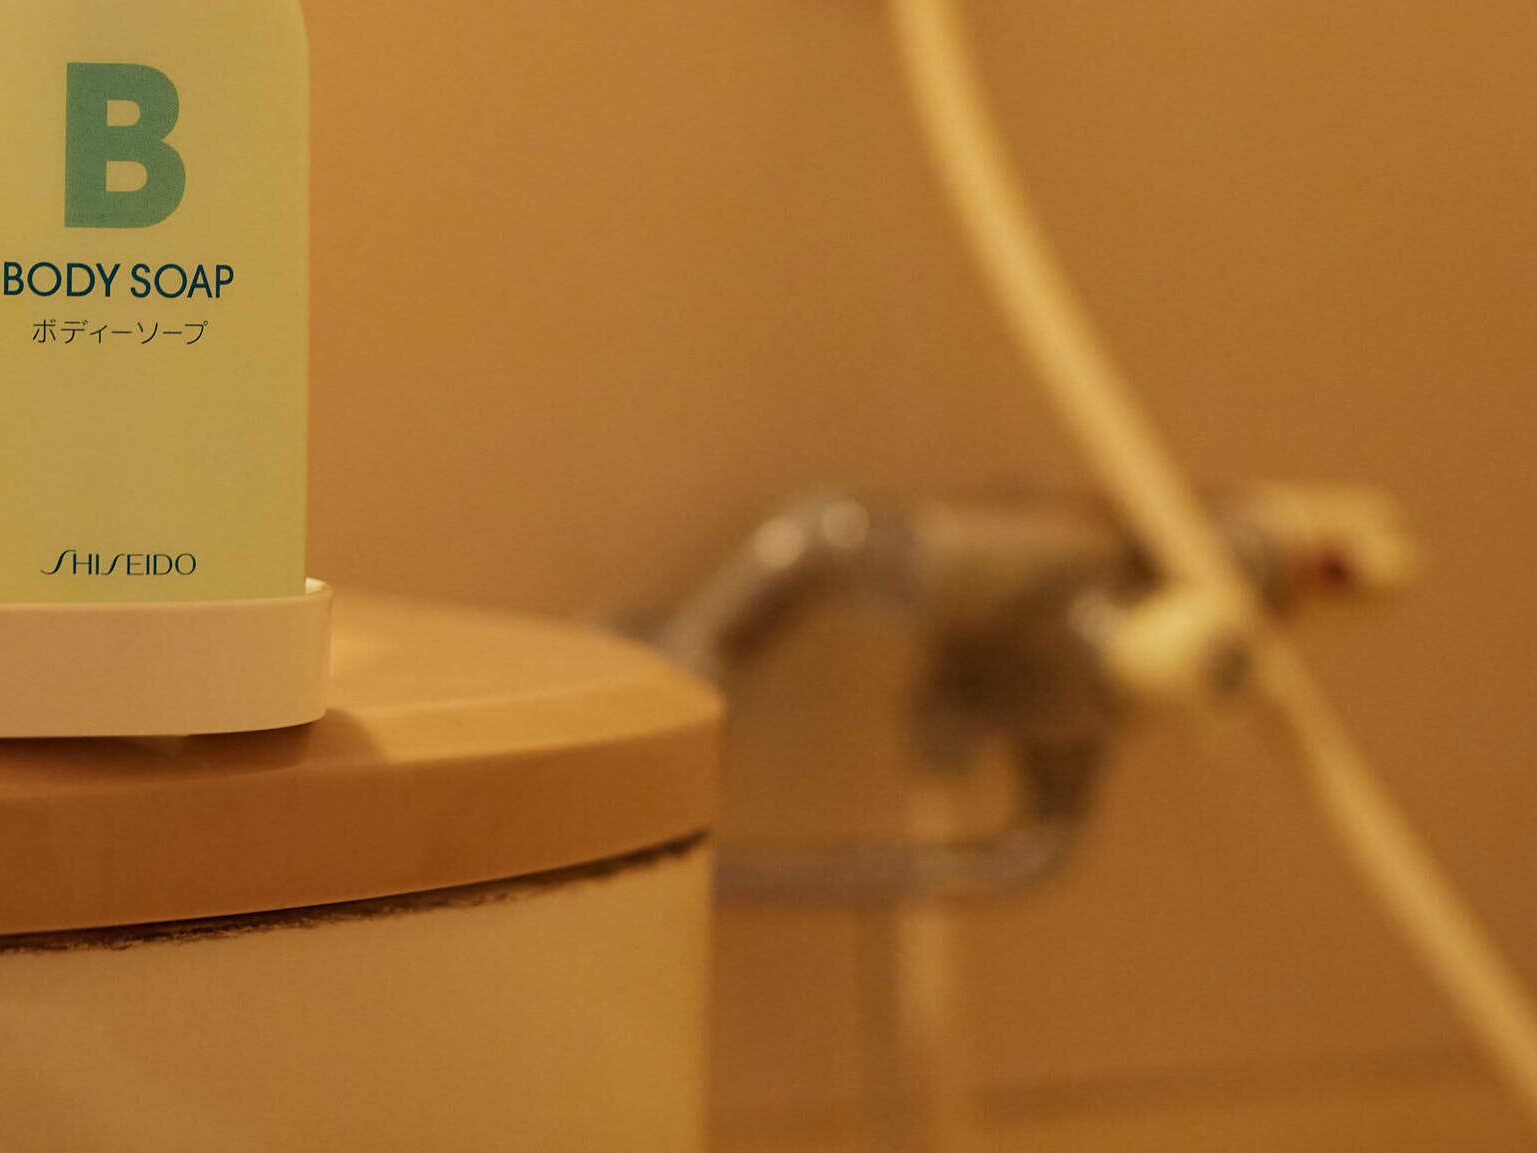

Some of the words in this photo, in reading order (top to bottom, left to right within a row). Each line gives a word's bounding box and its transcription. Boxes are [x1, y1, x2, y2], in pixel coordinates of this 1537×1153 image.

[65, 62, 186, 229] B
[3, 261, 121, 297] BODY
[130, 264, 234, 299] SOAP
[32, 319, 209, 345] ボディーソープ
[40, 549, 197, 576] SHISEIDO
